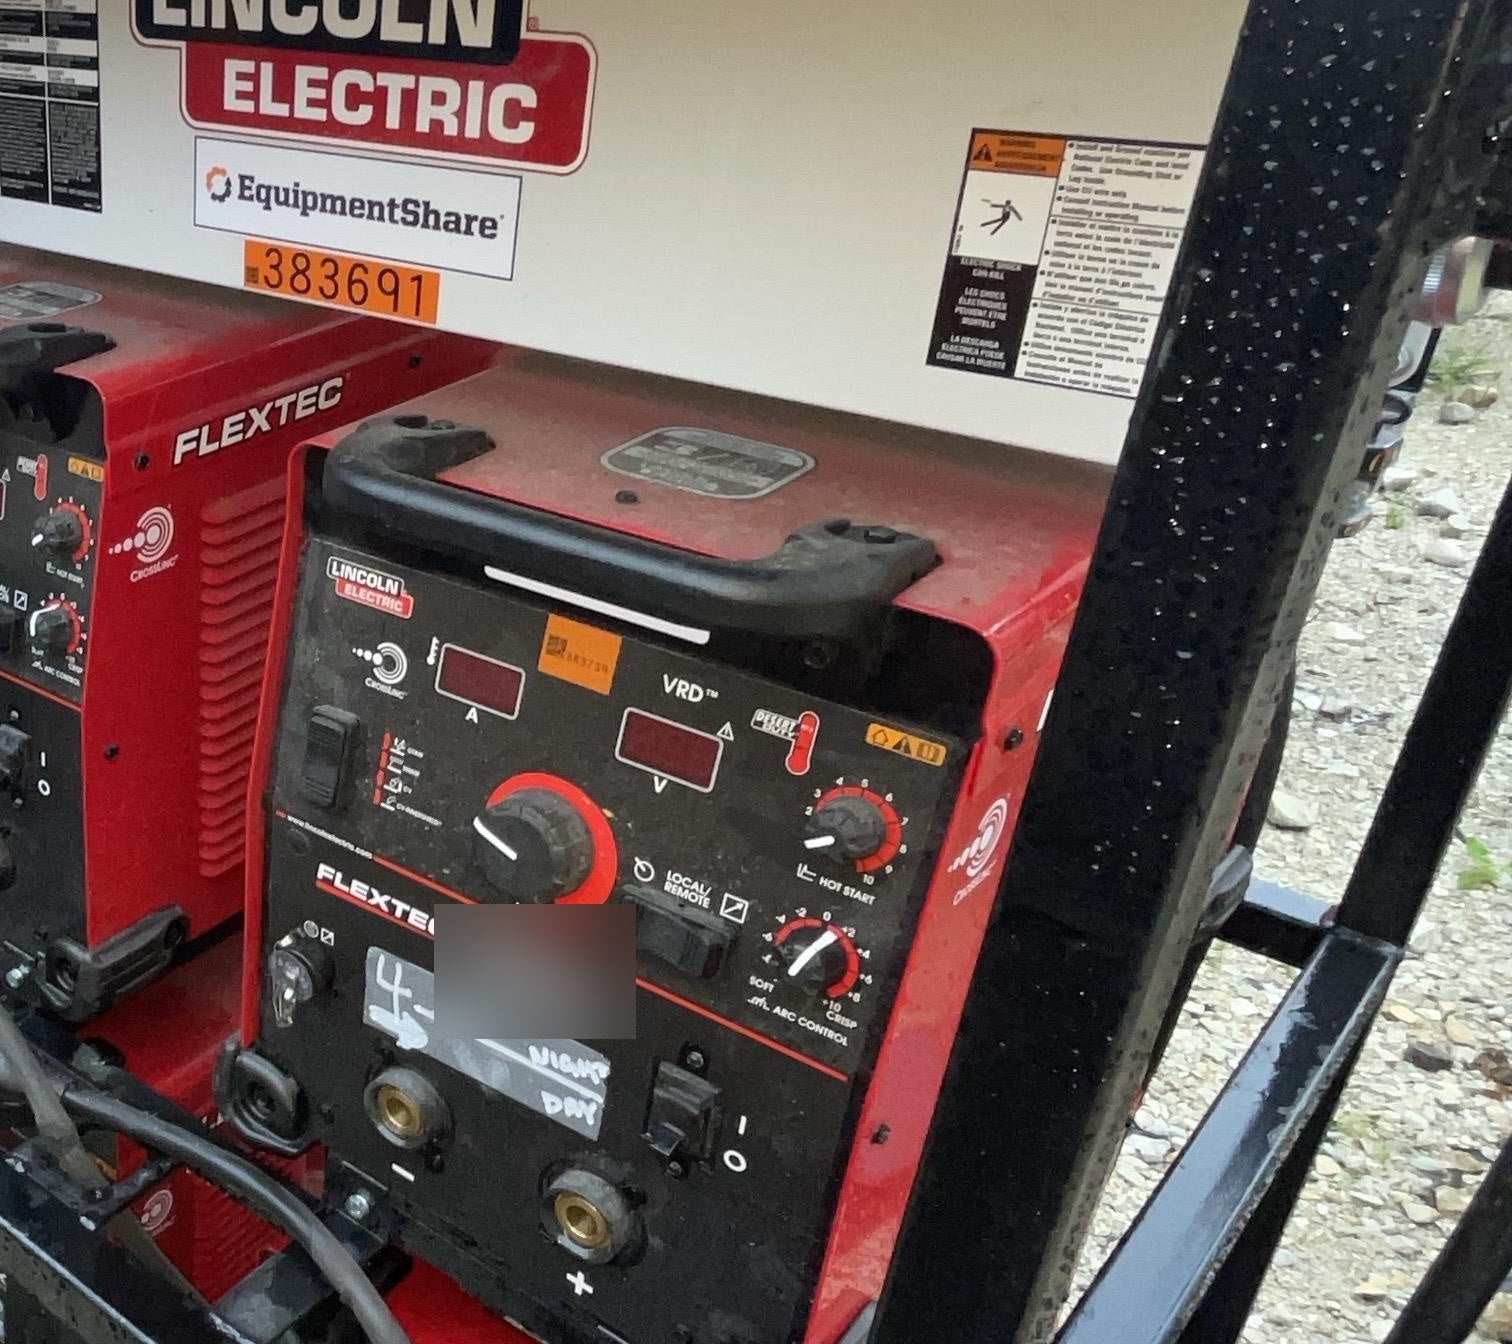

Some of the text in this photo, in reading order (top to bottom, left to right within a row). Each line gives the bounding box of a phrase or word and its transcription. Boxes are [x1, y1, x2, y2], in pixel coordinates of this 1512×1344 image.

[222, 58, 538, 145] ELECTRIC
[237, 174, 501, 241] EquipmentShare
[262, 246, 428, 318] 383691
[172, 376, 344, 466] FLEXTEC
[331, 560, 400, 596] LINCOLN
[343, 583, 404, 613] ELECTRIC
[464, 706, 479, 725] A
[652, 774, 669, 795] V
[813, 787, 823, 799] 3
[835, 775, 845, 787] 4
[804, 805, 814, 817] 2
[665, 868, 713, 896] LOCAL/
[818, 875, 877, 907] HOT START
[862, 873, 875, 886] 10
[663, 880, 712, 910] REMOTE
[822, 910, 832, 922] 0
[749, 974, 776, 994] SOFT
[771, 1004, 849, 1048] ARC CONTROL
[825, 1009, 859, 1031] CRISP
[540, 1090, 598, 1127] DAY
